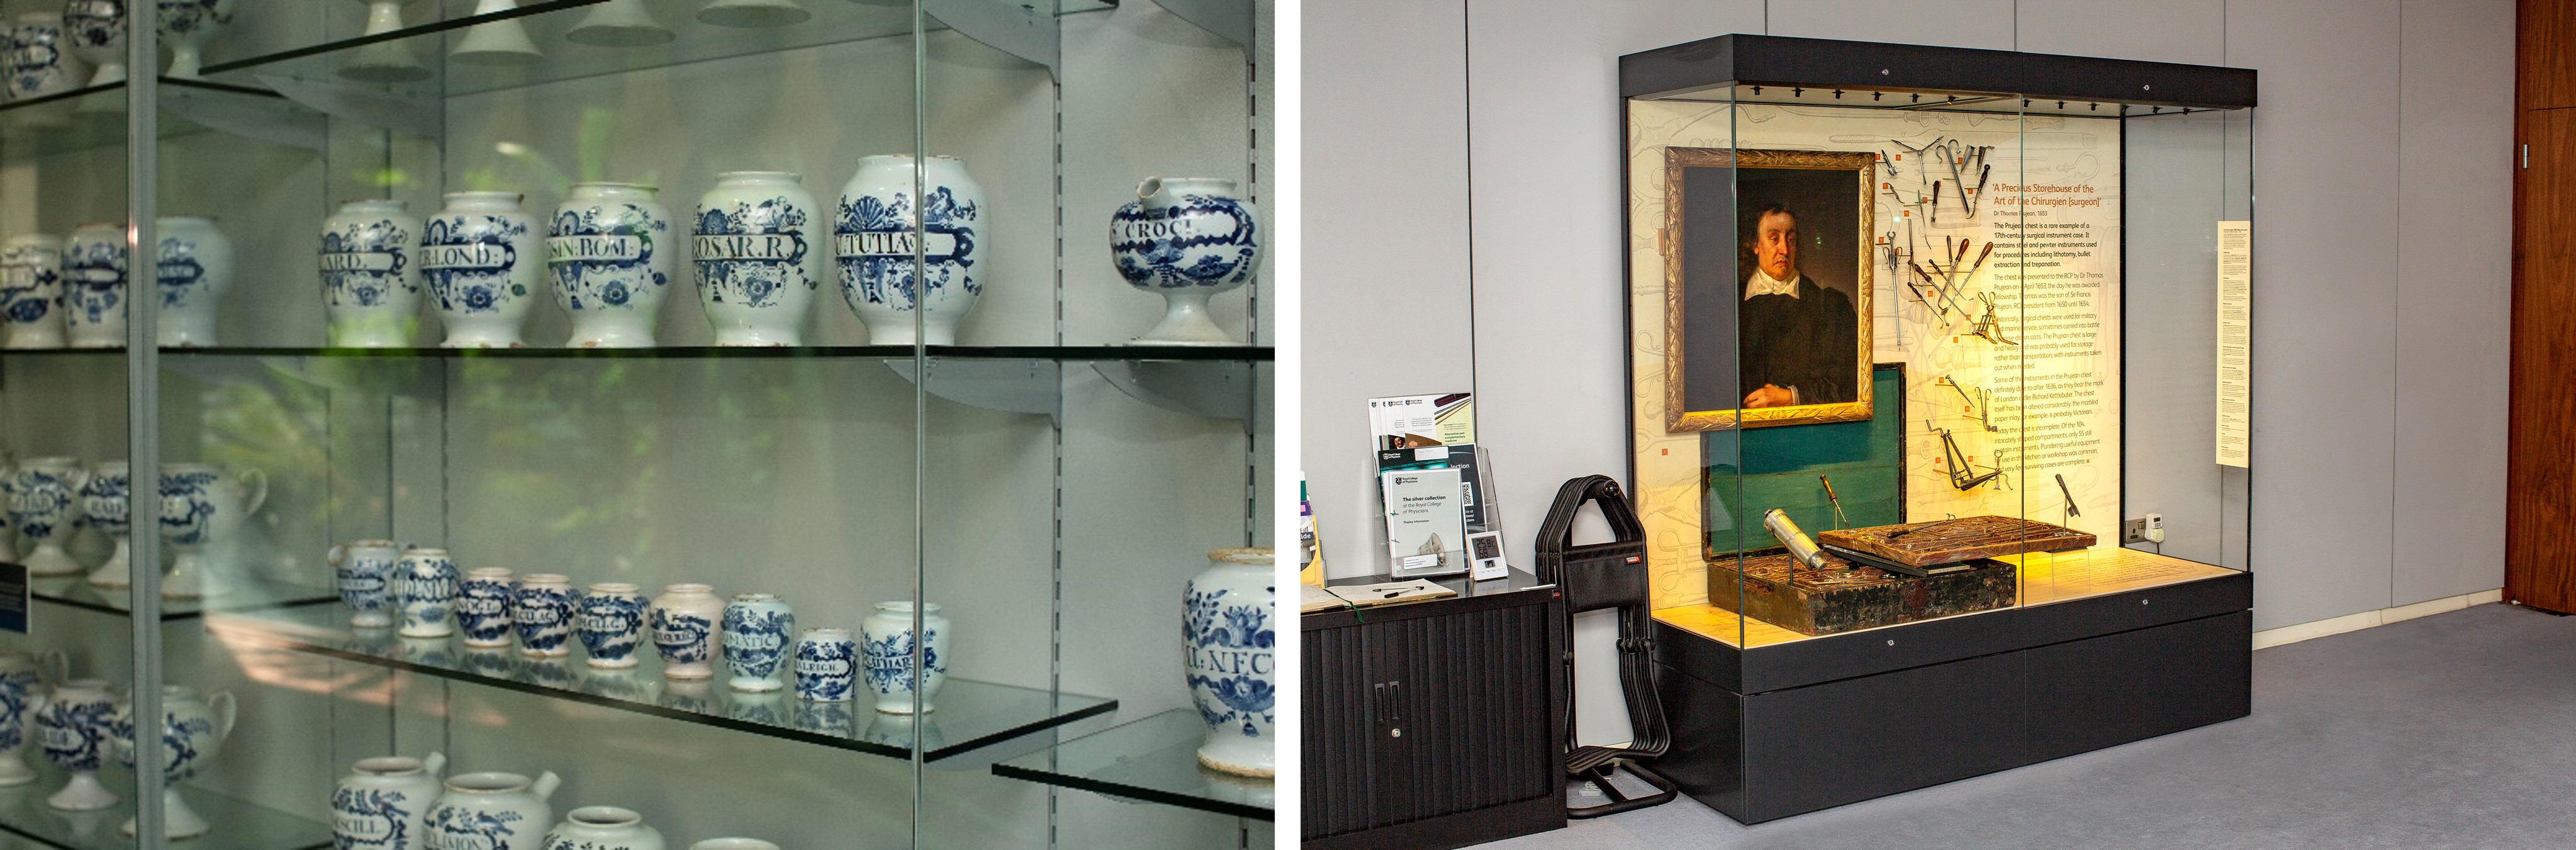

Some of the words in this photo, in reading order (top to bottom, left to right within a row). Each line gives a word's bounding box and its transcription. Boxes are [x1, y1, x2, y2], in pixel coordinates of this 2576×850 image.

[1993, 184, 1999, 192] ‘A
[2033, 184, 2071, 193] Storehouse
[2073, 184, 2080, 193] of
[2082, 184, 2094, 193] the
[1993, 196, 2005, 205] Art
[2007, 197, 2015, 205] of
[2030, 197, 2066, 208] Chirurgien
[2068, 197, 2101, 208] [surgeon]’
[2021, 352, 2053, 361] ansportation,
[2063, 372, 2080, 381] Prujean
[1995, 386, 2015, 394] definitely
